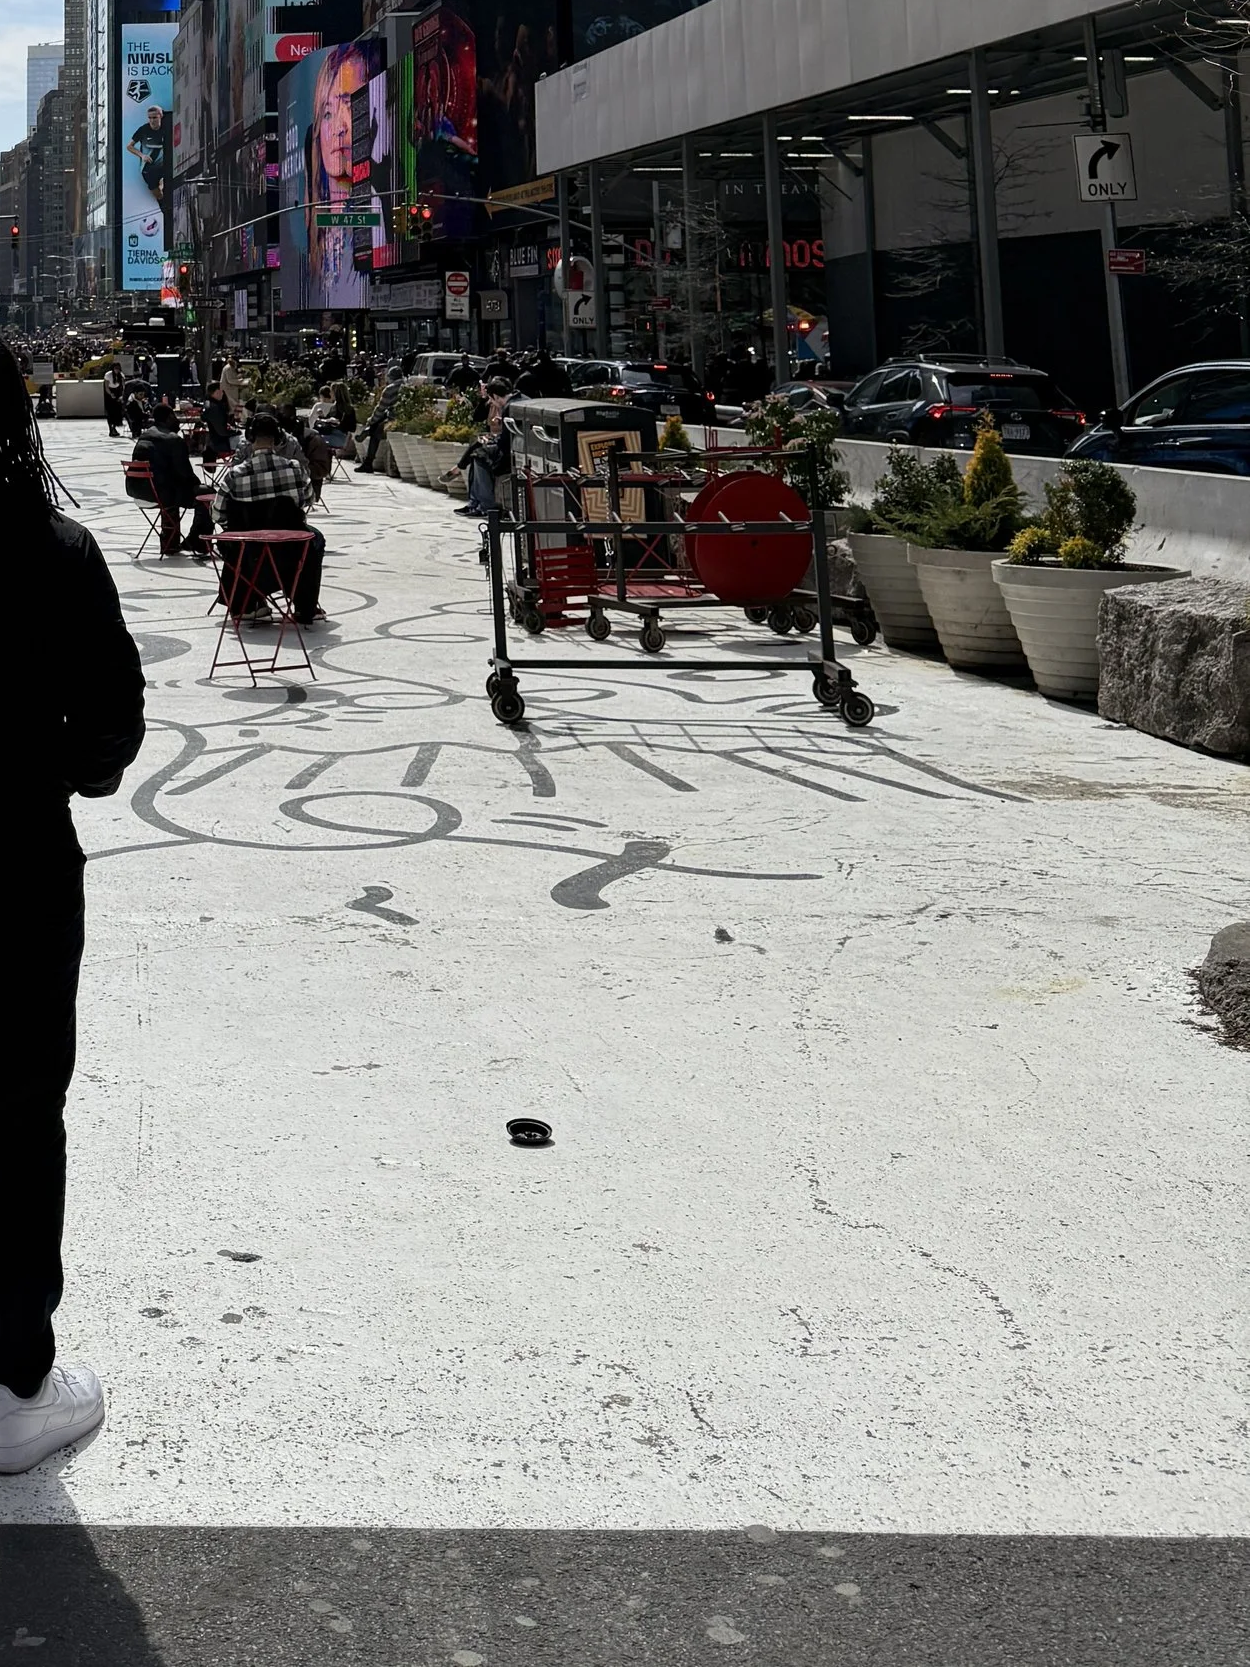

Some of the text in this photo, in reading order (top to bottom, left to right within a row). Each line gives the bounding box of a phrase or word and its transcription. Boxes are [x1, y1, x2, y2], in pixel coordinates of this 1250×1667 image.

[126, 41, 151, 52] THE
[127, 52, 174, 65] NWSL
[127, 65, 174, 77] IS BACK
[725, 183, 744, 195] IN
[1087, 182, 1128, 197] ONLY
[330, 214, 366, 224] W 47 St
[127, 249, 158, 257] TIERNA
[509, 243, 539, 266] BLUE FIN
[127, 256, 165, 265] DAVIDSO
[571, 315, 596, 325] ONLY
